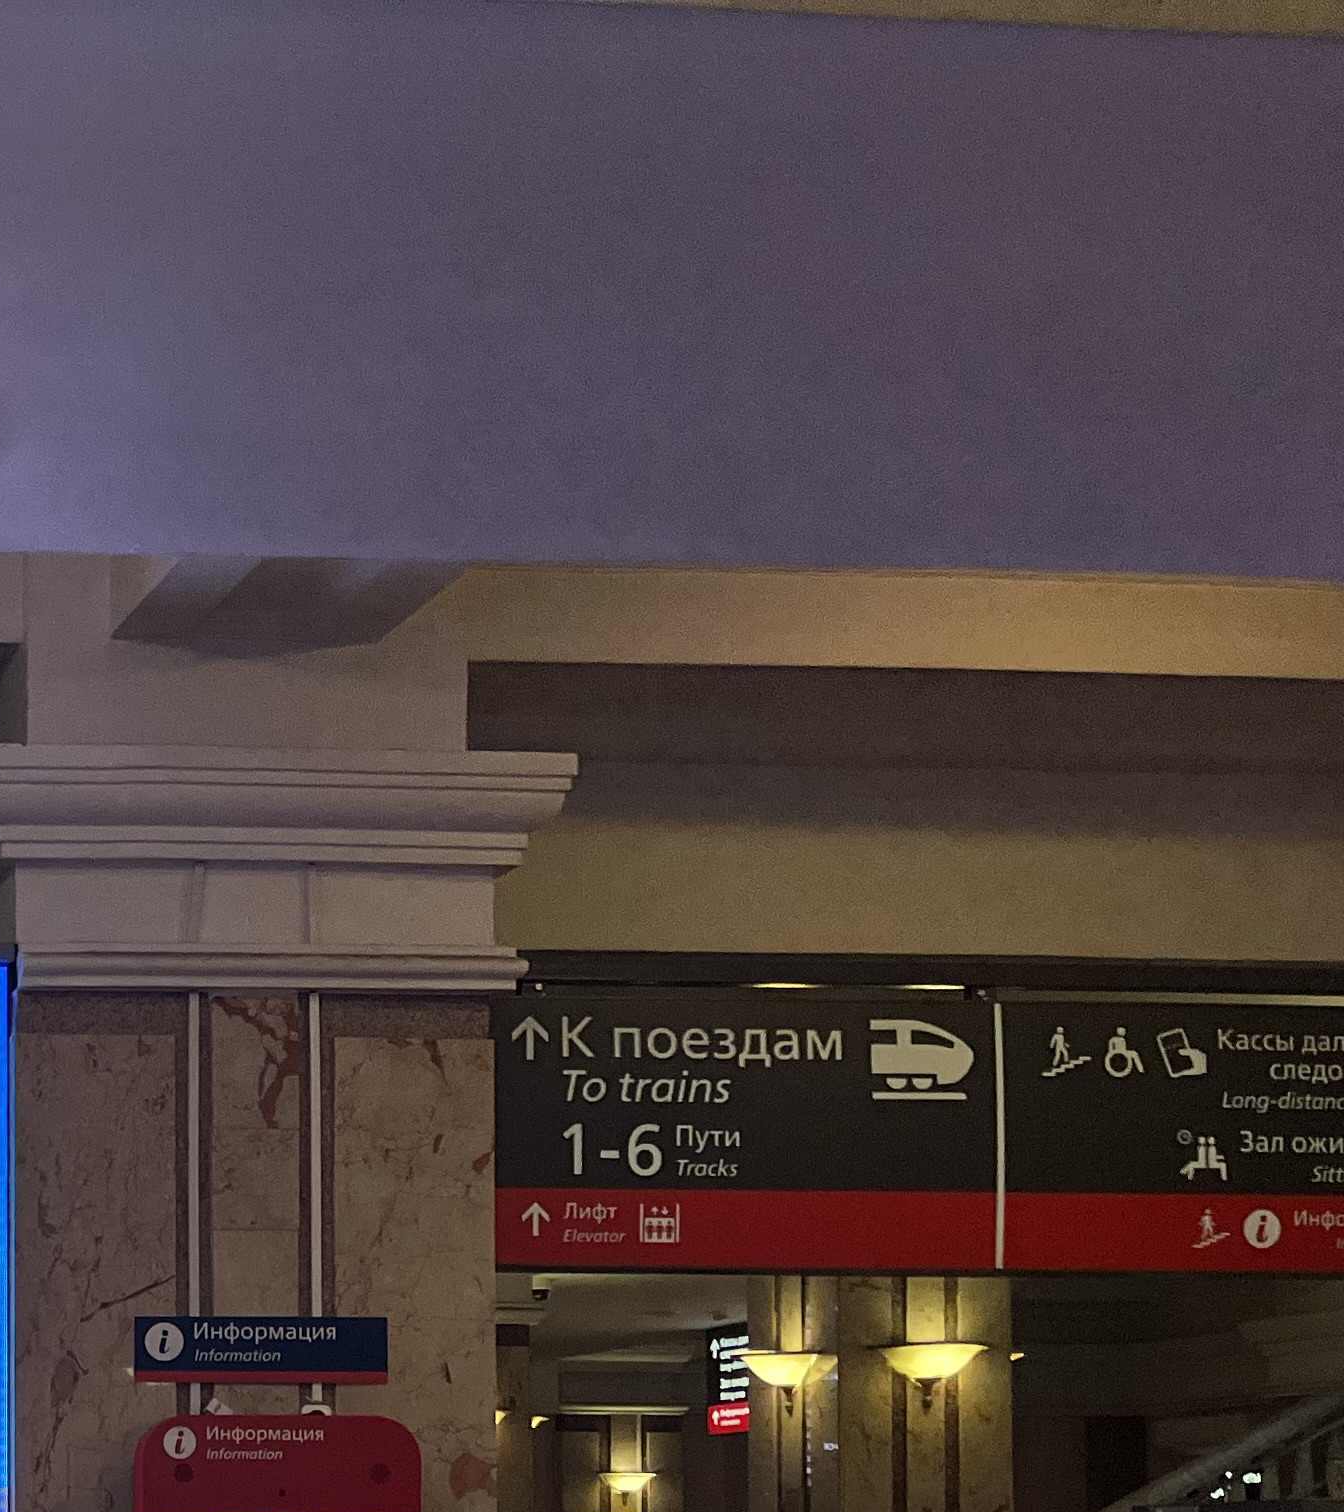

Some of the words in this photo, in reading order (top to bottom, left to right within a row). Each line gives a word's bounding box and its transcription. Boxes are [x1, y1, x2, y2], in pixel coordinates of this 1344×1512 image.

[561, 1016, 594, 1058] К
[613, 1027, 843, 1068] поездам
[1217, 1028, 1294, 1051] Кассы
[563, 1070, 607, 1103] To
[618, 1071, 730, 1104] trains
[676, 1125, 741, 1150] Пути
[1239, 1130, 1284, 1153] Зал
[561, 1122, 662, 1177] 1-6
[676, 1159, 738, 1178] Tracks
[563, 1202, 617, 1224] Лифт
[562, 1228, 626, 1244] Elevator
[193, 1322, 337, 1342] Информация
[194, 1348, 281, 1363] Information
[205, 1426, 325, 1444] Информация
[205, 1448, 283, 1461] Information
